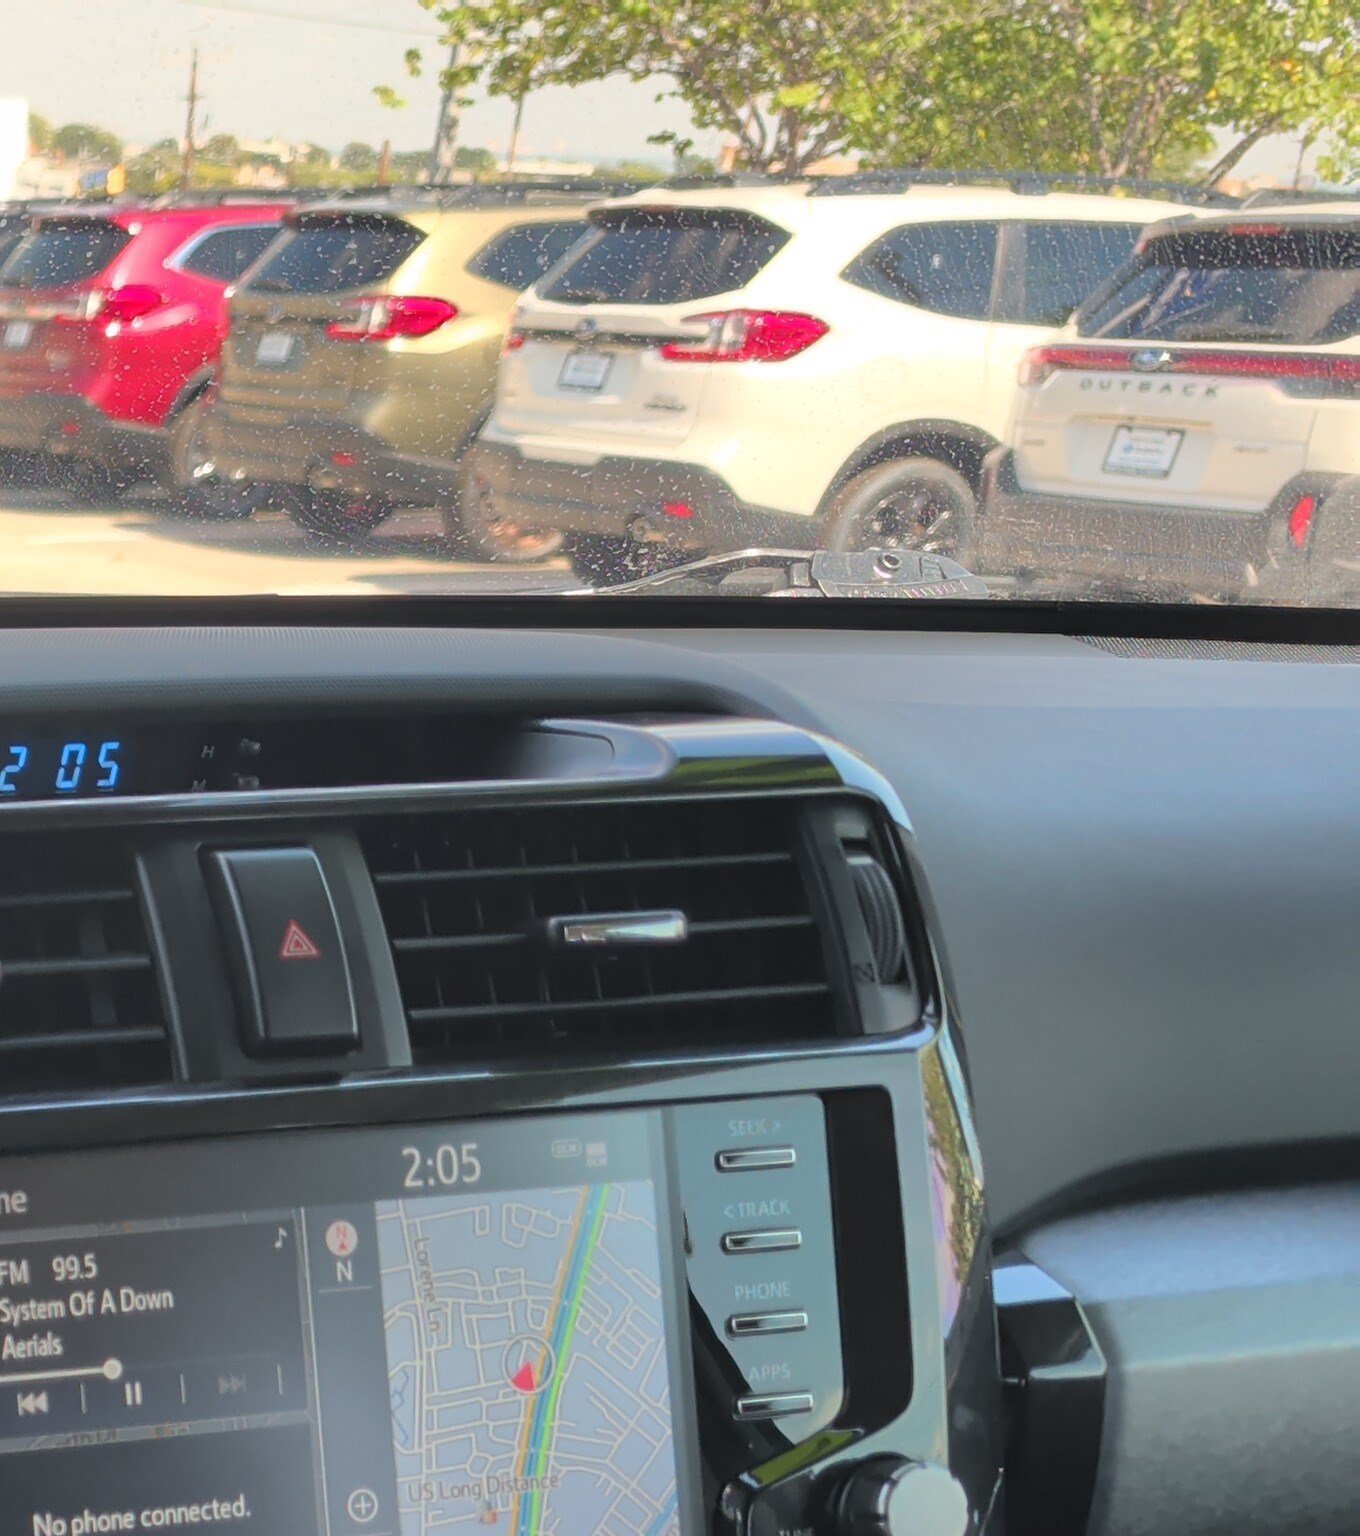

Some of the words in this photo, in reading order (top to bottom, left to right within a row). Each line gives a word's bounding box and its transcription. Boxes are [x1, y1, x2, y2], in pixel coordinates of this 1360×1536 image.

[1080, 377, 1220, 398] OUTBACK
[402, 1142, 481, 1189] 2:05
[737, 1198, 791, 1216] TRACK
[52, 1253, 99, 1282] 99.5
[335, 1261, 353, 1283] N
[69, 1291, 95, 1318] Of
[100, 1291, 116, 1314] A
[120, 1286, 174, 1313] Down
[734, 1281, 791, 1300] PHONE
[1, 1330, 63, 1361] Aerials
[749, 1363, 792, 1381] APPS
[408, 1482, 435, 1502] US
[439, 1477, 482, 1502] Long
[486, 1471, 561, 1496] Distance
[140, 1493, 252, 1527] connected.
